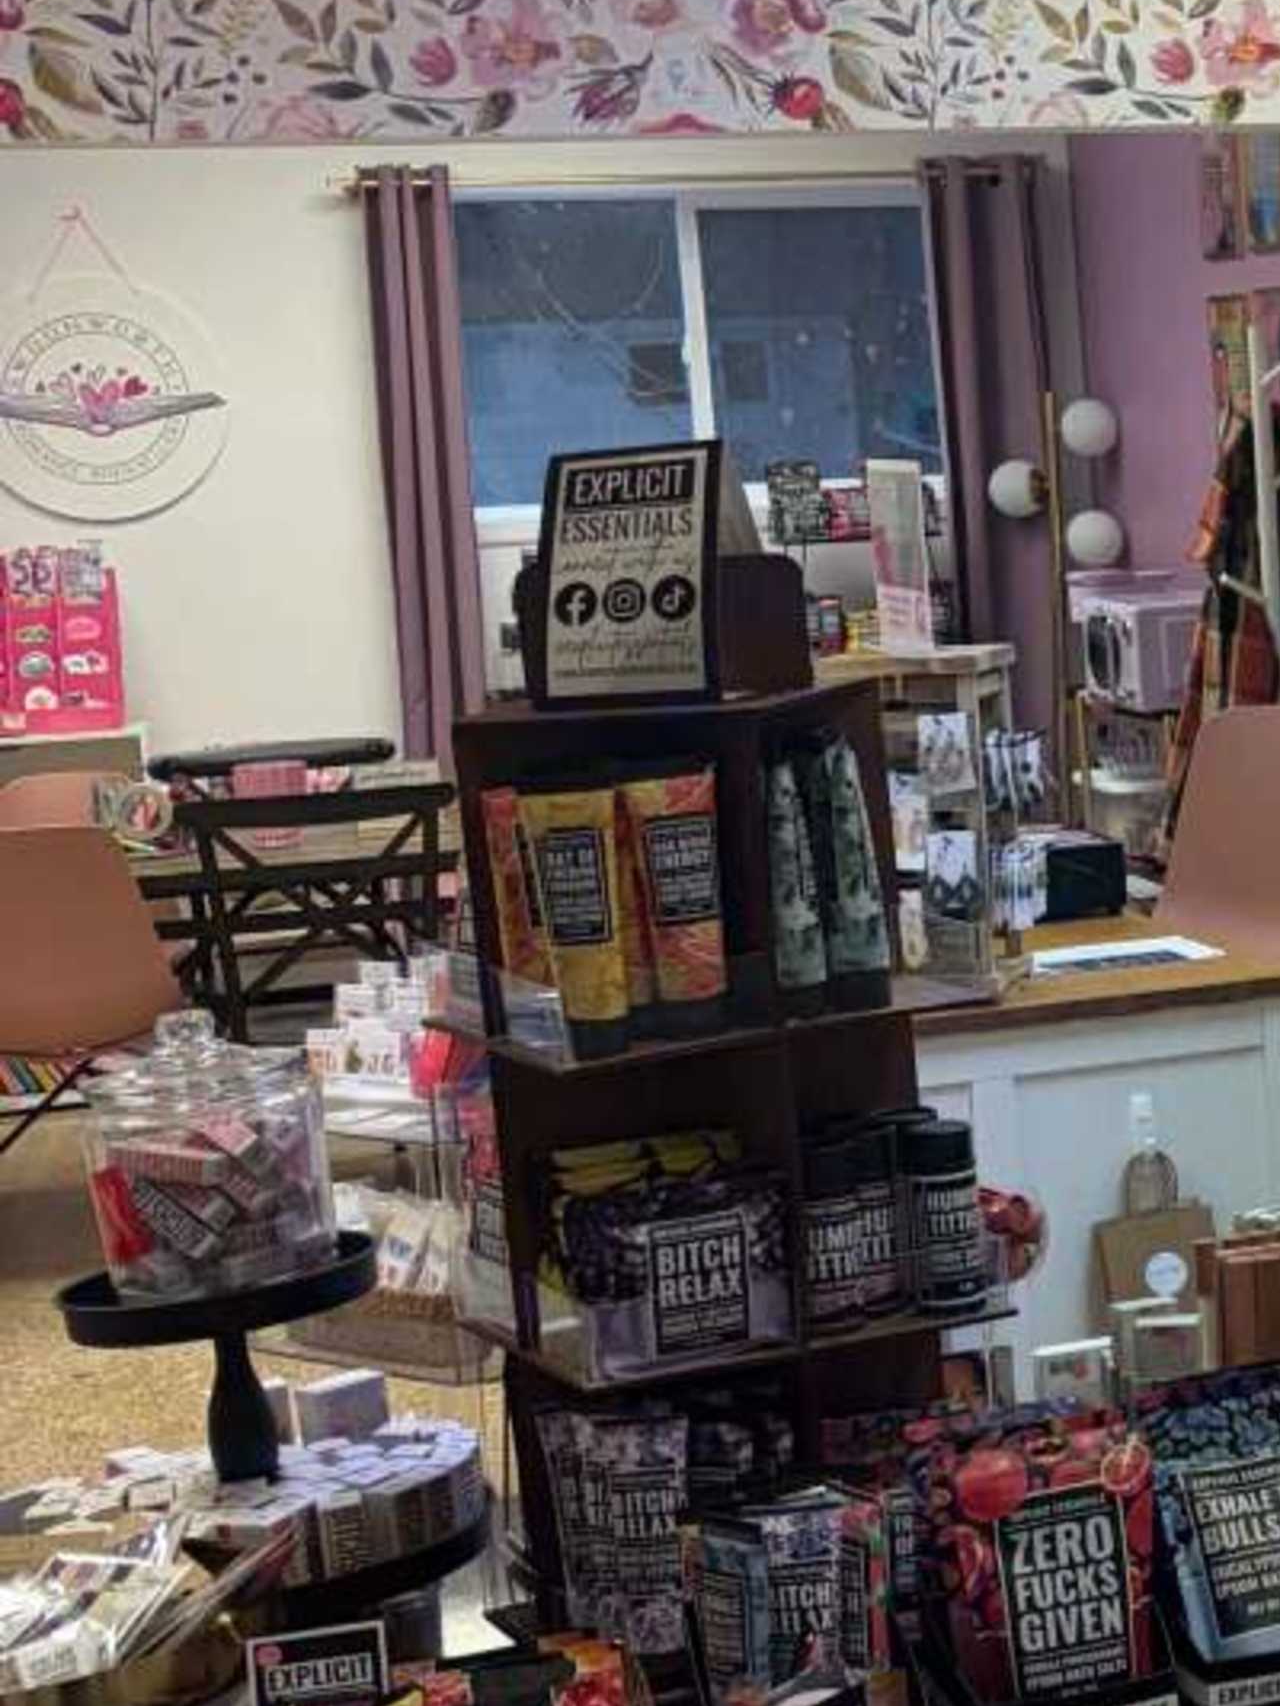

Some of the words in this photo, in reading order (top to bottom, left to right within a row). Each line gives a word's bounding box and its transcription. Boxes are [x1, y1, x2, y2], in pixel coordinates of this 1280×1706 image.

[574, 465, 687, 506] EXPLICIT
[562, 507, 692, 544] ESSENTIALS
[657, 1236, 742, 1277] BITCH
[659, 1267, 744, 1308] RELAX
[1194, 1489, 1273, 1523] EXHALE
[1012, 1514, 1115, 1576] ZERO
[1014, 1560, 1121, 1612] FUCKS
[1019, 1597, 1124, 1654] GIVEN
[267, 1653, 373, 1692] EXPLICIT
